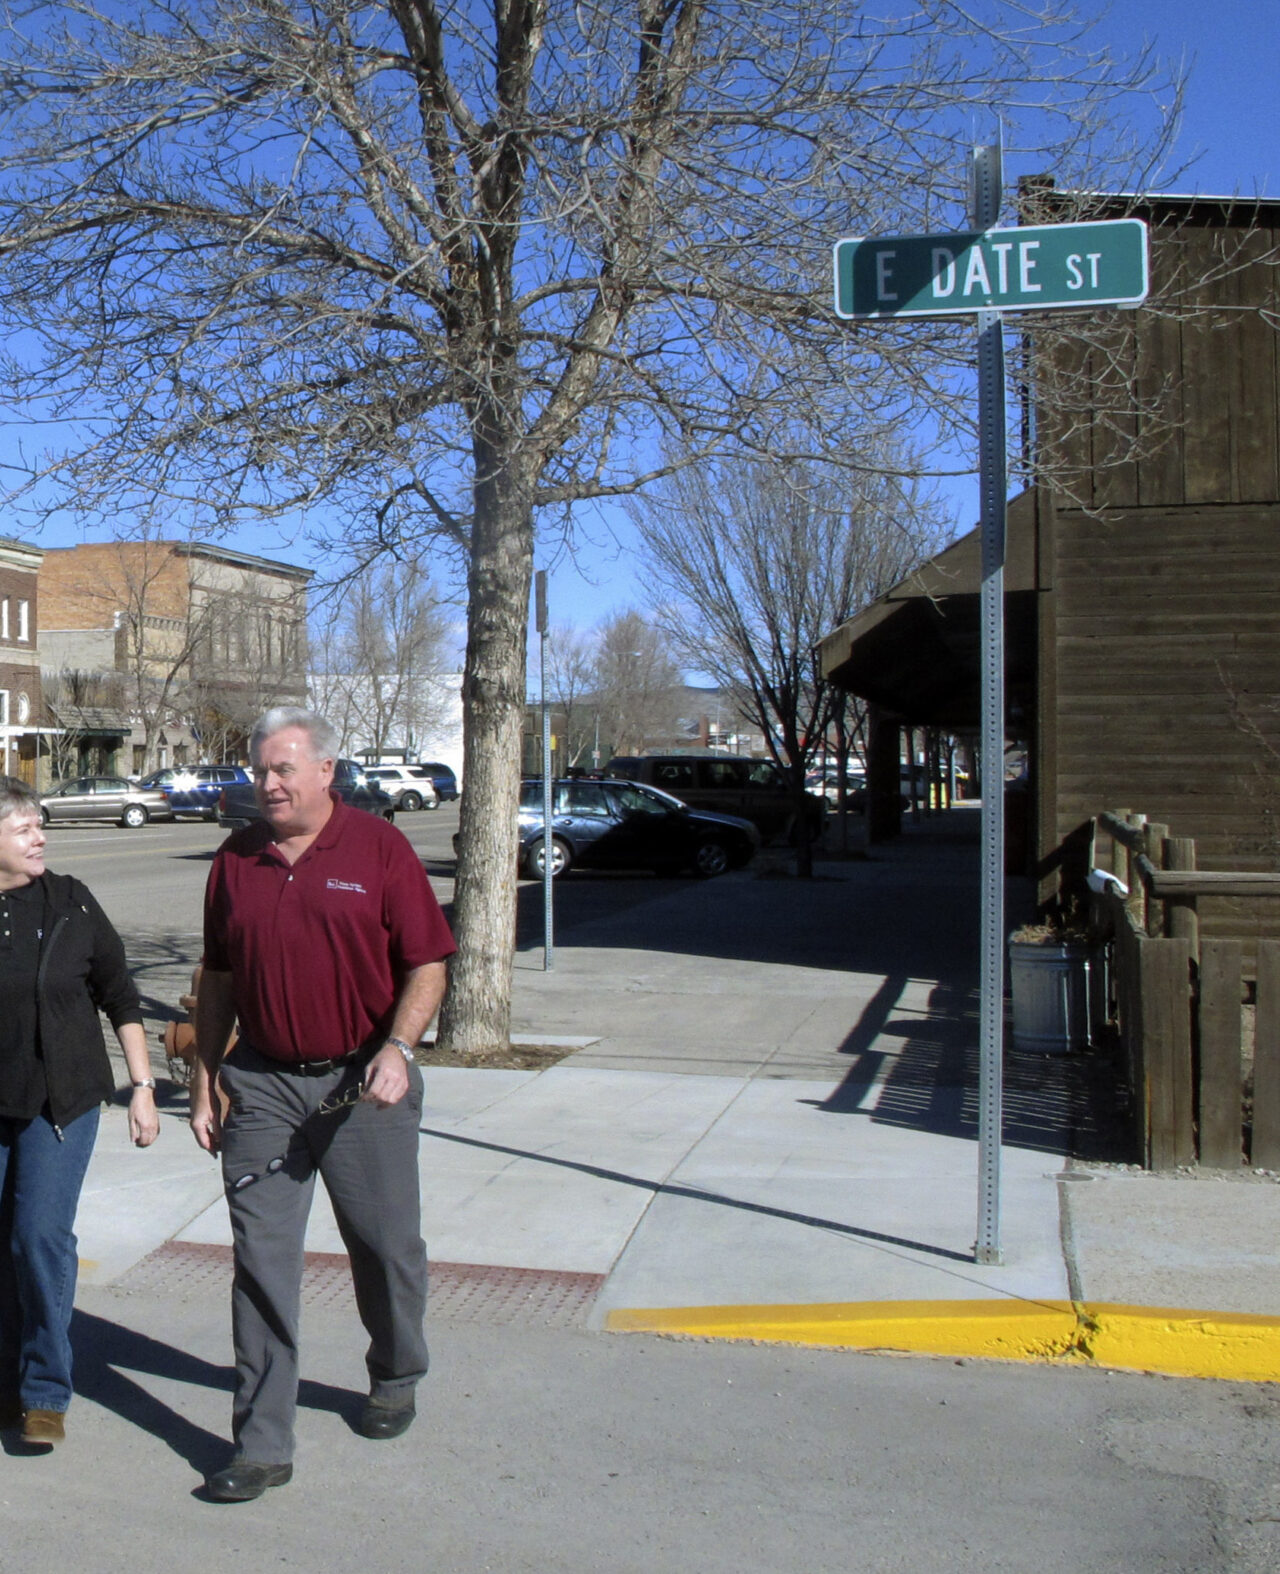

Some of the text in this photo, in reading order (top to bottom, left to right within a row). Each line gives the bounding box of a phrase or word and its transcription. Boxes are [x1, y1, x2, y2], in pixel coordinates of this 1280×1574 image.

[876, 240, 1102, 301] E DATE ST
